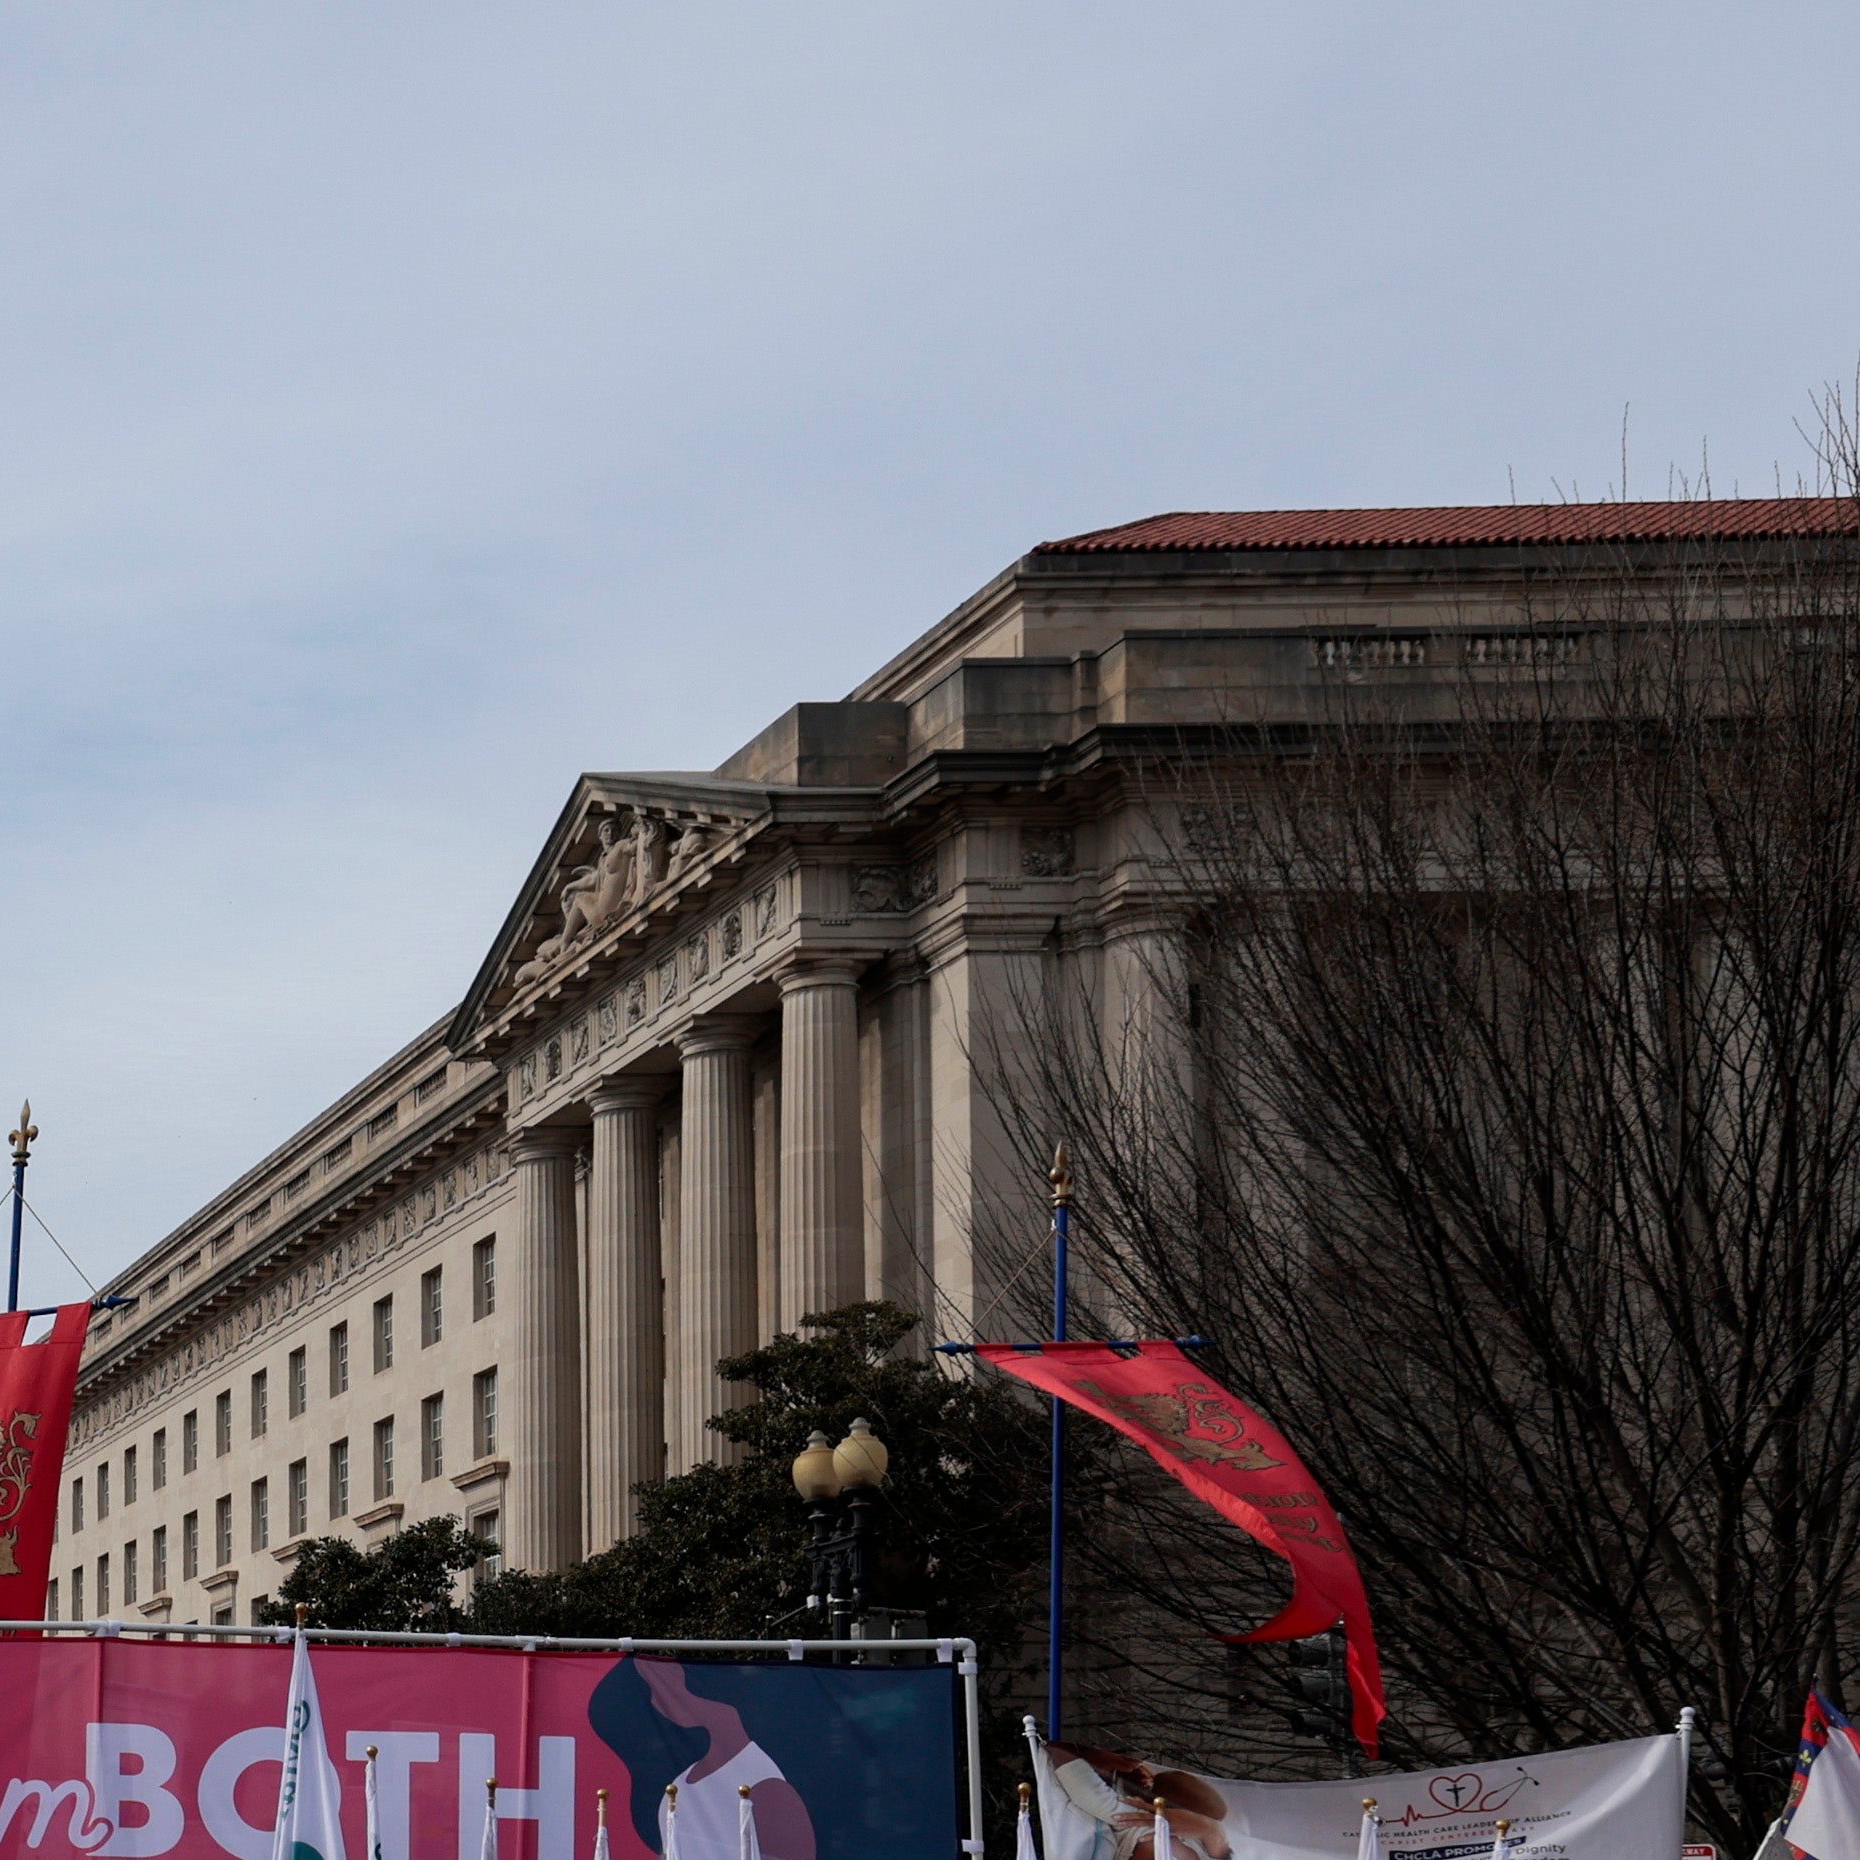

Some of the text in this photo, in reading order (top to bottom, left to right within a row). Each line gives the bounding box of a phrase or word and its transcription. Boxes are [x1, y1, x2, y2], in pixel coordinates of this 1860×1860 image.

[1433, 1825, 1459, 1834] CARE
[1393, 1848, 1442, 1860] CHCLA
[1515, 1844, 1567, 1855] Dignity
